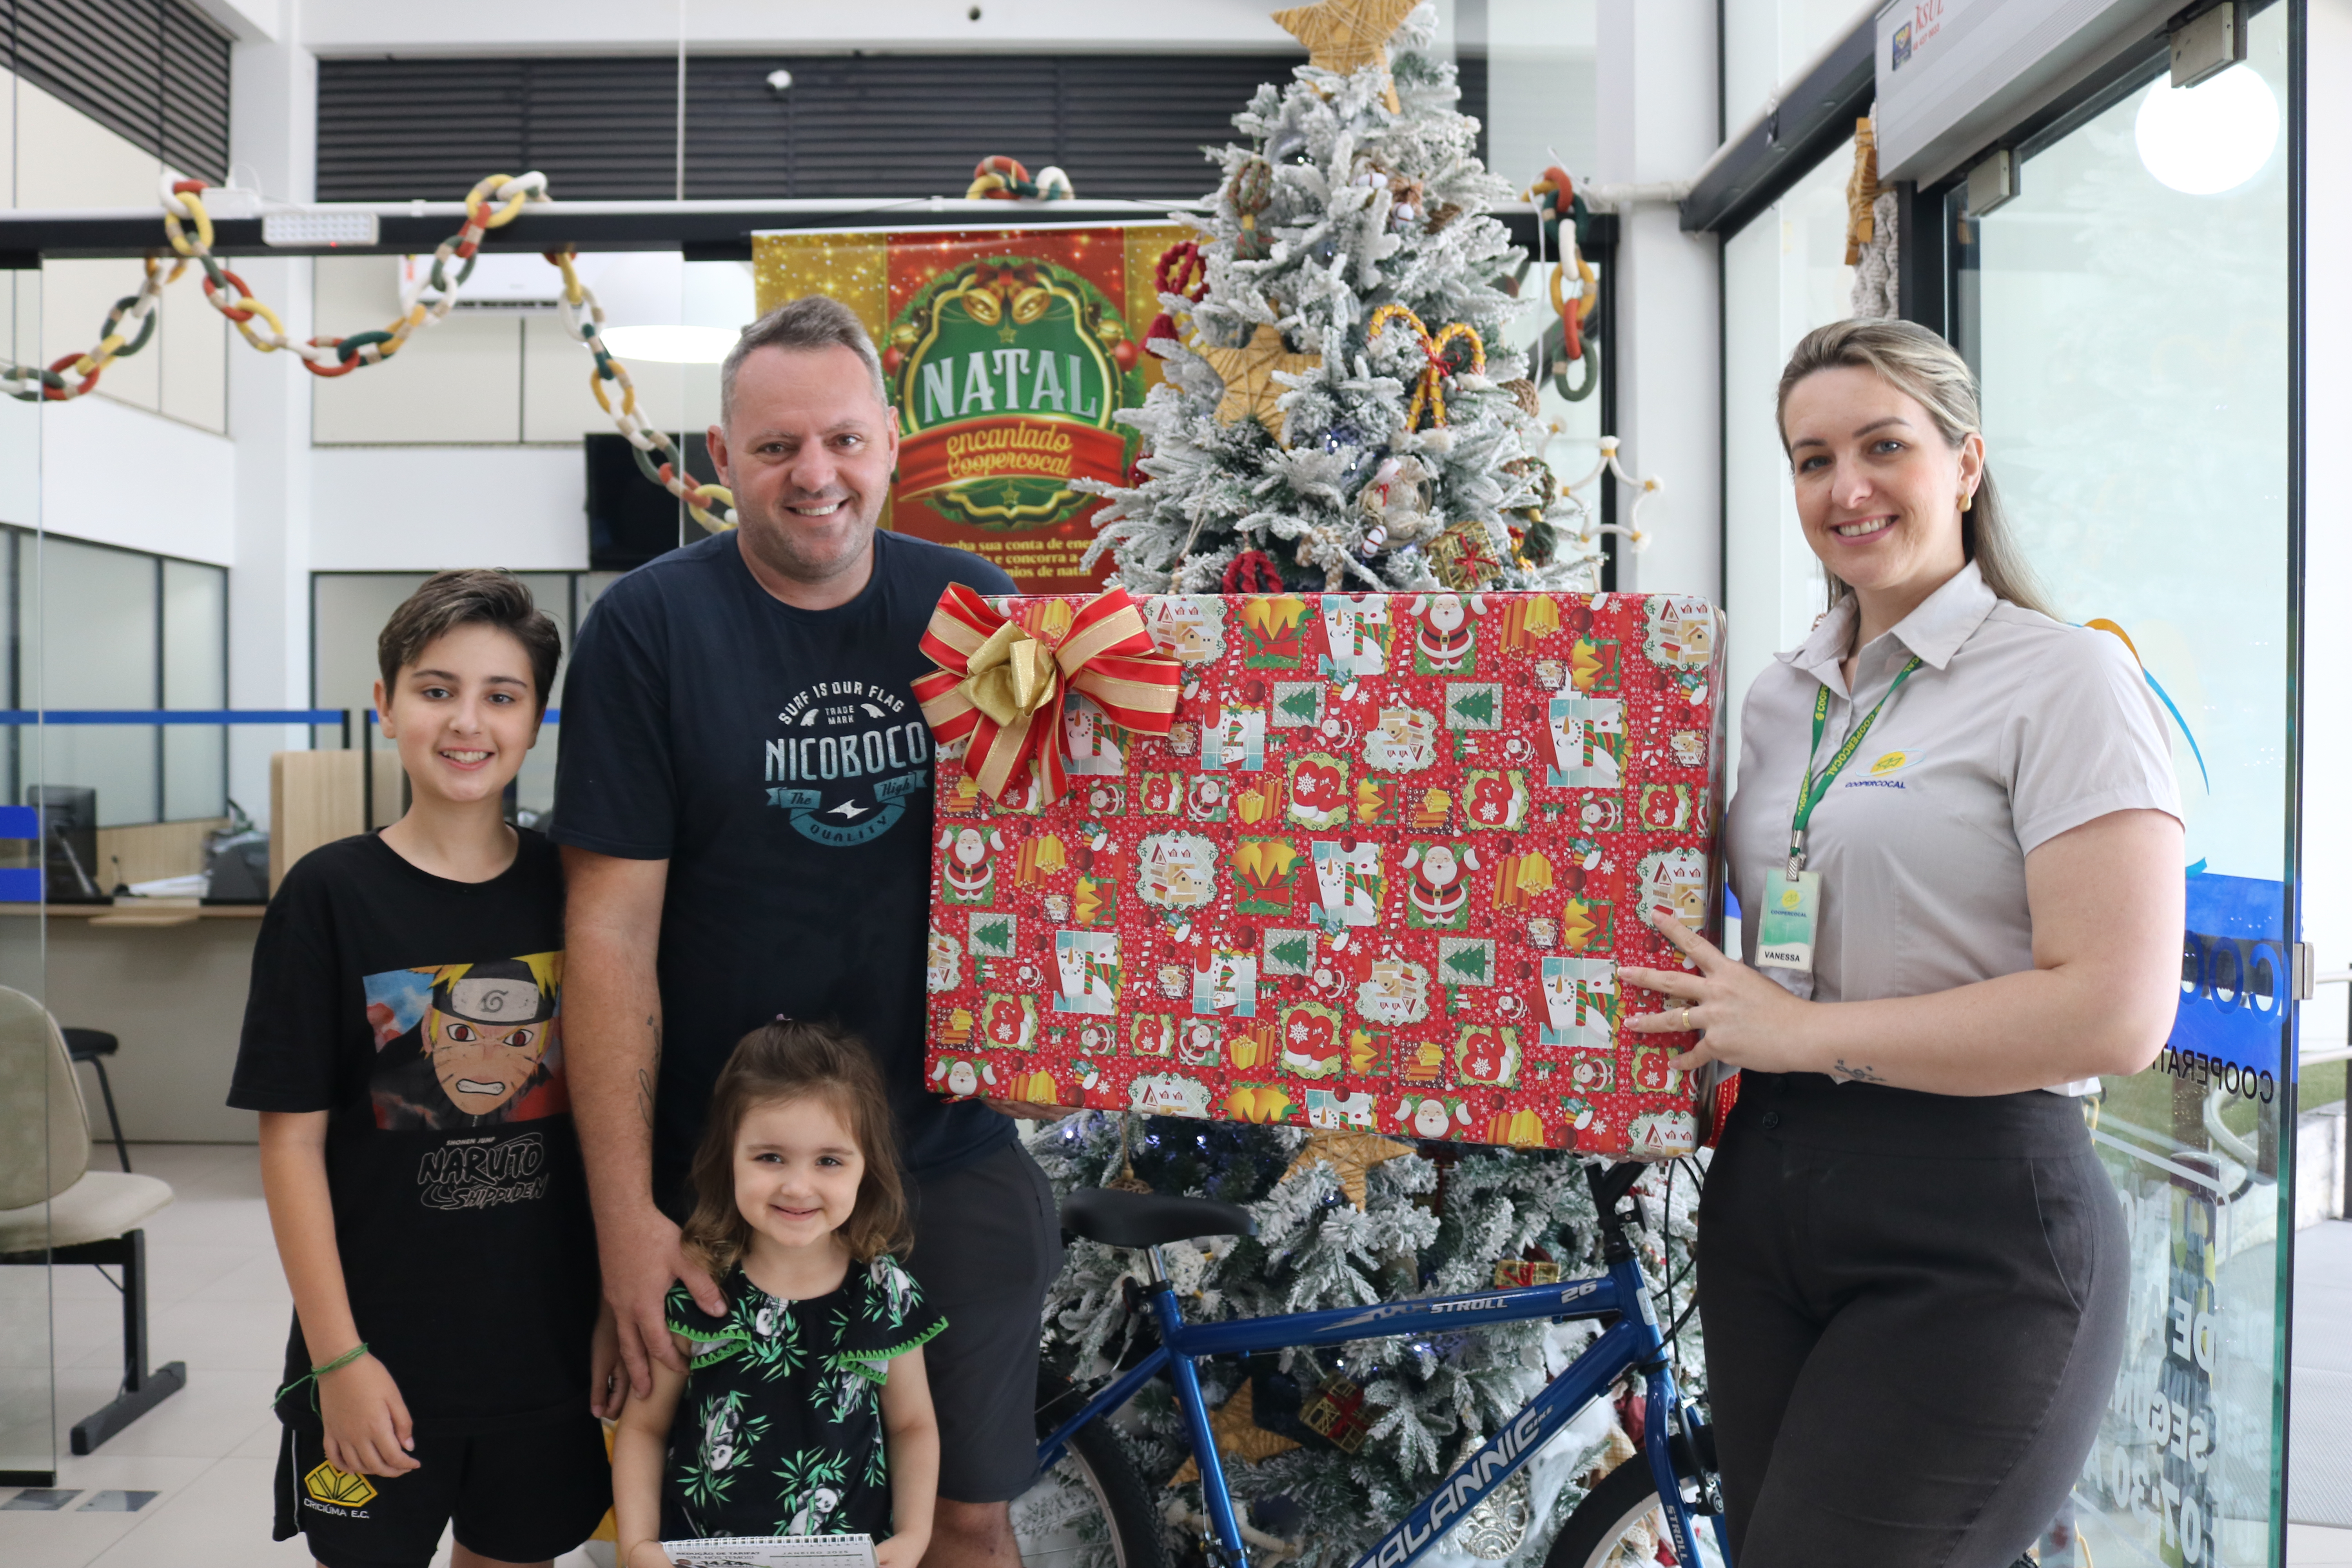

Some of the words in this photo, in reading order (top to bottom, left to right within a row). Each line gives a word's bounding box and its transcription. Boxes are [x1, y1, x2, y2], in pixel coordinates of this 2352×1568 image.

[922, 348, 1096, 423] NATAL
[946, 421, 1073, 456] encantado
[947, 451, 1073, 478] Coopercocal
[978, 541, 1003, 551] sua
[1005, 540, 1044, 551] conta
[1047, 538, 1063, 550] de
[995, 555, 1003, 565] e
[1005, 554, 1067, 564] concorra
[1069, 553, 1078, 563] a
[1037, 565, 1054, 577] de
[778, 691, 810, 725] SURF
[812, 682, 828, 698] IS
[831, 681, 863, 695] OUR
[868, 685, 904, 713] FLAG
[825, 705, 855, 716] TRADE
[828, 715, 854, 725] MARK
[765, 722, 927, 782] NICOBOCO
[1826, 713, 1875, 776] COOPERCOCAL
[790, 792, 811, 805] The
[881, 777, 910, 797] High
[810, 815, 887, 842] QUALITY
[1770, 909, 1807, 917] COOPERCOCAL
[1764, 951, 1800, 962] VANESSA
[417, 1142, 544, 1185] NARUTO
[439, 1173, 550, 1210] SHIPPUDEN
[1430, 1298, 1508, 1314] STROLL
[1561, 1280, 1597, 1304] 26
[303, 1498, 347, 1517] CRICIÚMA
[351, 1510, 370, 1519] E.C.
[1666, 1504, 1690, 1561] STROLL
